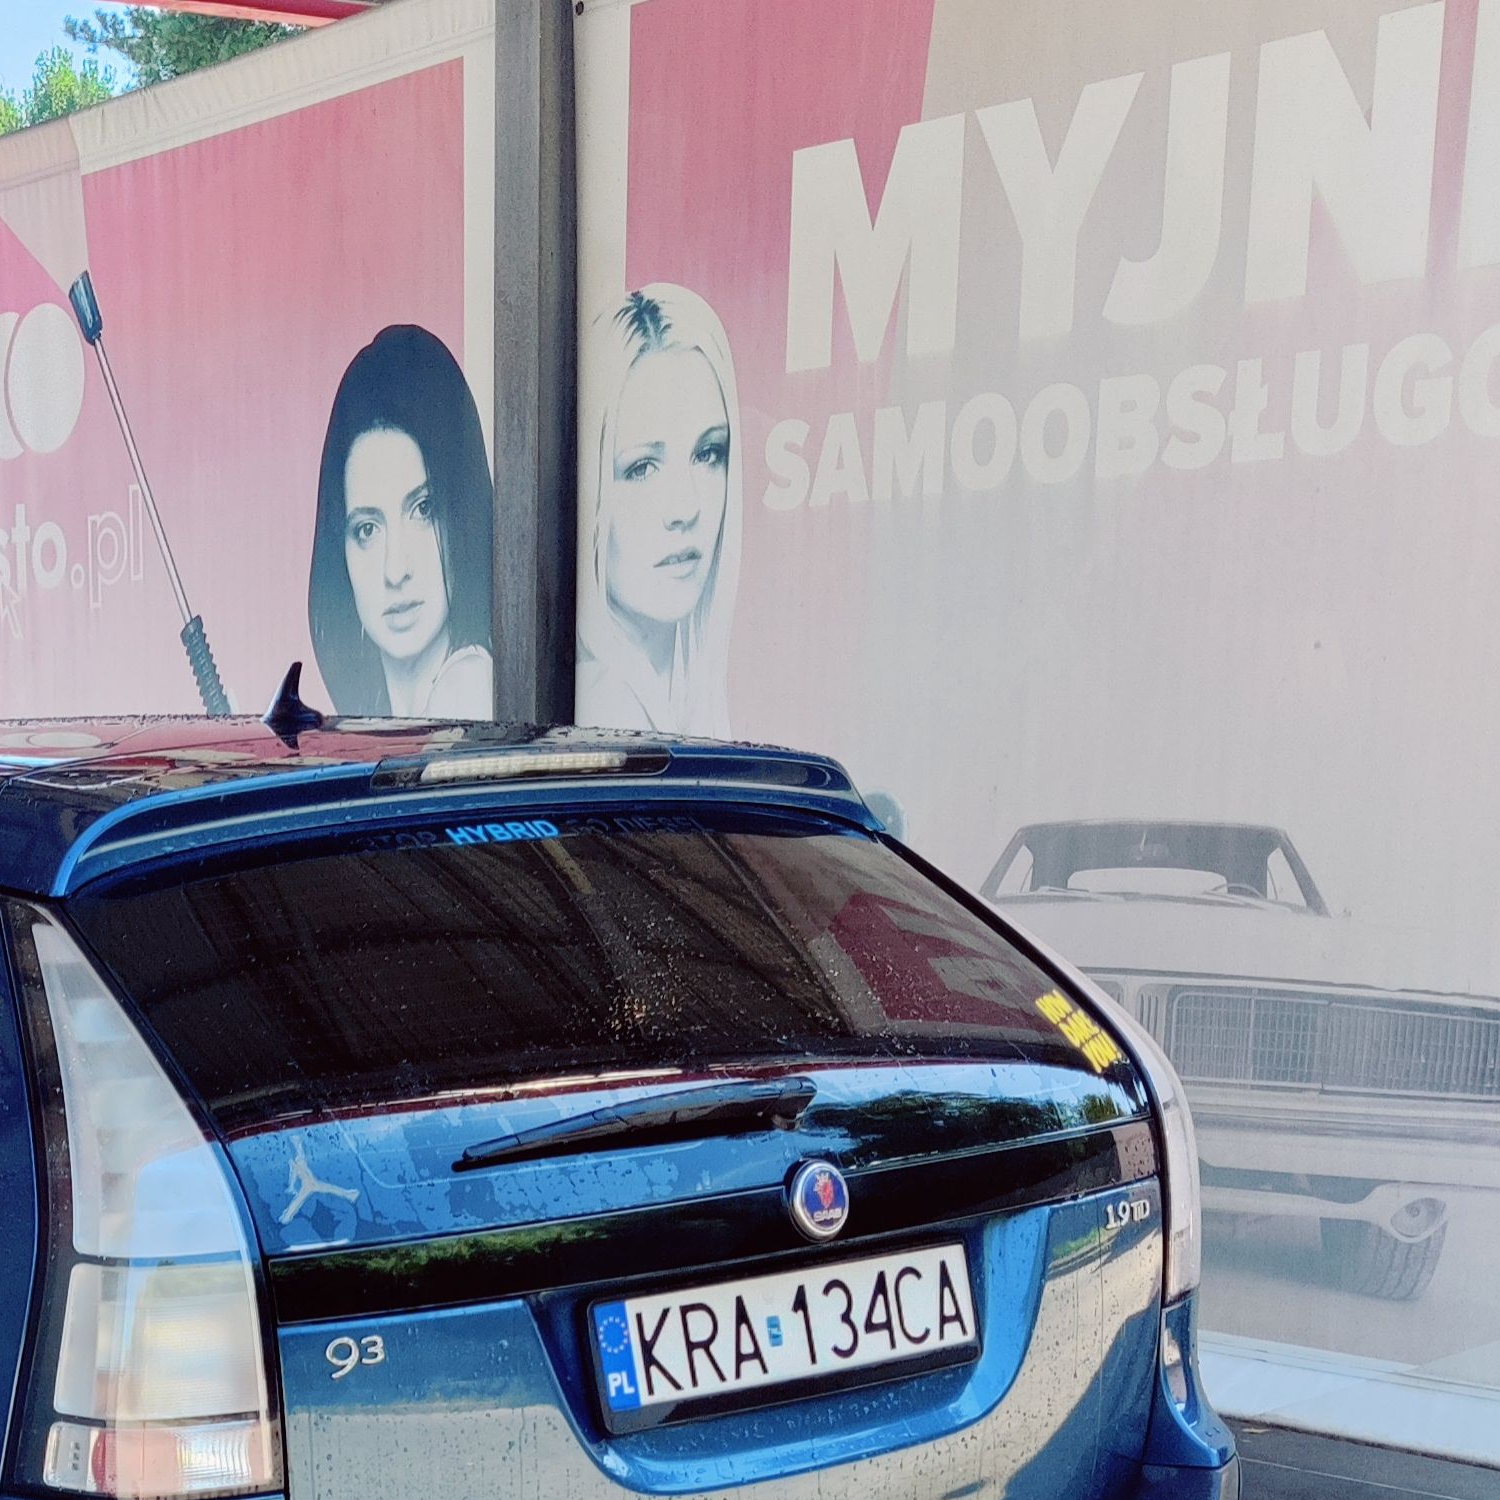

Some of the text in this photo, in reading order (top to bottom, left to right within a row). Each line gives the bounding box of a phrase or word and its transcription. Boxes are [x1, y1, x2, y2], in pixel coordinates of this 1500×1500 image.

[445, 819, 560, 846] HYBRID
[635, 1259, 968, 1396] KRA 134CA
[607, 1371, 635, 1398] PL
